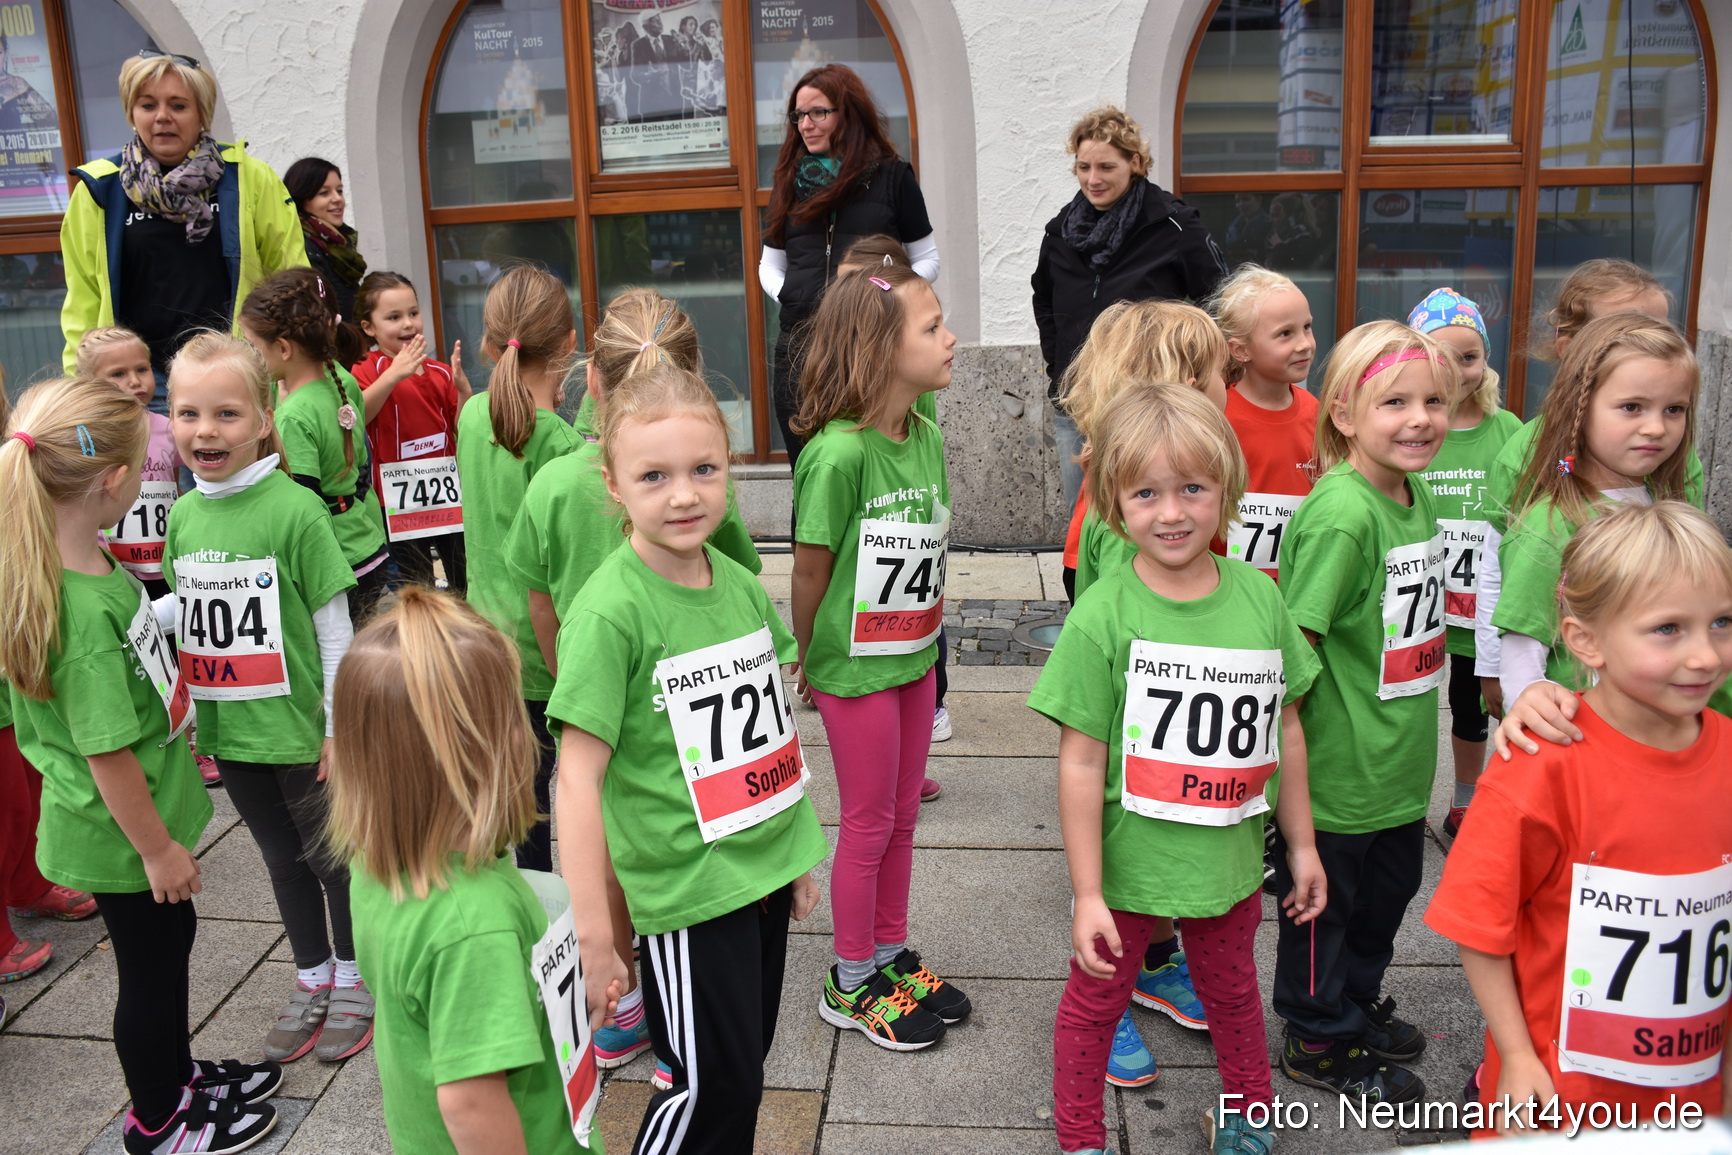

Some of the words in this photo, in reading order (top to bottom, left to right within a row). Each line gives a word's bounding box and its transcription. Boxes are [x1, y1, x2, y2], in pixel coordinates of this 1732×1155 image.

[0, 4, 35, 37] OOD
[761, 7, 803, 18] KulTour
[761, 17, 798, 29] NACHT
[812, 15, 834, 27] 2015
[474, 29, 513, 40] KulTour
[475, 40, 509, 51] NACHT
[522, 37, 543, 48] 2015
[620, 125, 640, 134] 2016
[641, 122, 682, 132] Reitstadel
[28, 132, 48, 147] 20:00
[14, 150, 53, 164] Neumarkt
[414, 440, 434, 452] DEHN
[383, 469, 412, 479] PARTL
[414, 465, 448, 475] Neumarkt
[139, 490, 171, 500] Neumarkt
[392, 476, 458, 510] 7428
[117, 504, 174, 538] 18
[394, 511, 454, 530] ANNABELLE
[864, 533, 916, 550] PARTL
[1242, 522, 1283, 562] 71
[191, 576, 250, 591] Neumarkt
[179, 596, 268, 649] 7404
[268, 641, 275, 651] K
[192, 657, 238, 682] EVA
[1134, 658, 1197, 681] PARTL
[1202, 666, 1277, 685] Neumarkt
[667, 664, 730, 694] PARTL
[1147, 687, 1278, 760] 7081
[1131, 743, 1136, 754] 1
[693, 765, 700, 777] 1
[745, 755, 798, 798] Sophia
[1181, 773, 1247, 801] Paula
[1579, 887, 1668, 917] PARTL
[541, 929, 577, 985] PARTL
[1600, 918, 1732, 1005] 716
[1576, 993, 1583, 1006] 1
[566, 1063, 572, 1077] 1
